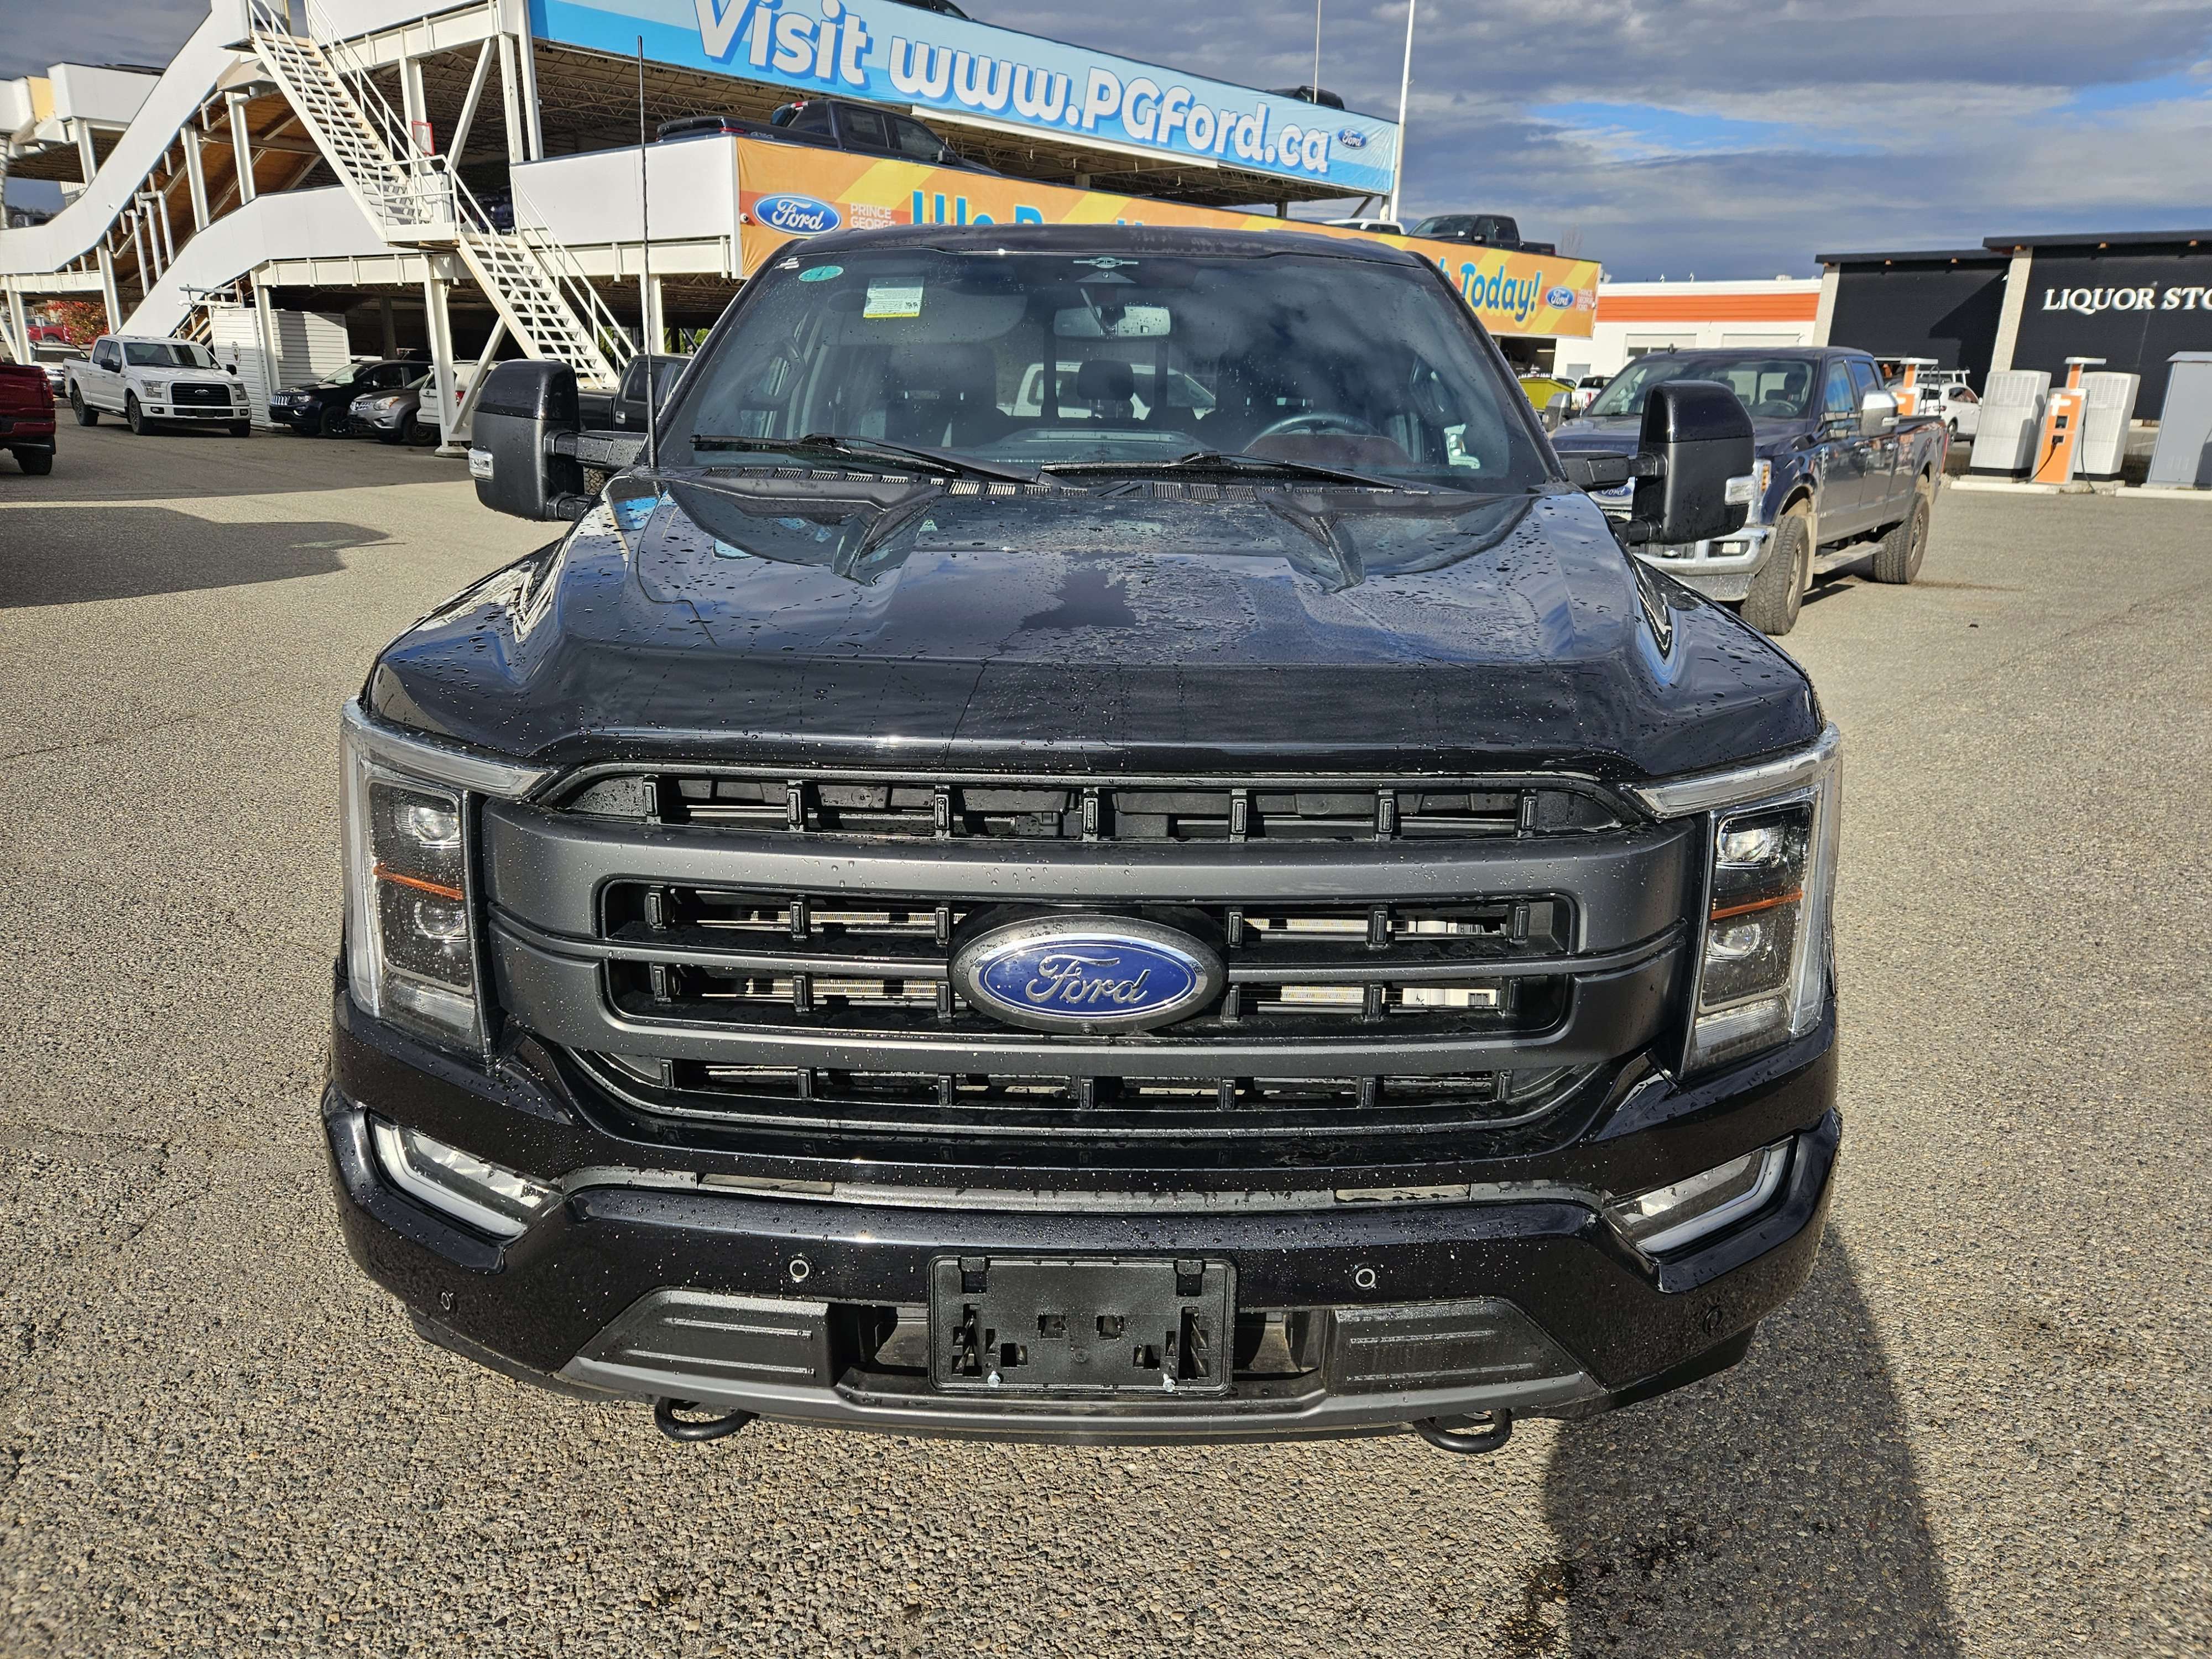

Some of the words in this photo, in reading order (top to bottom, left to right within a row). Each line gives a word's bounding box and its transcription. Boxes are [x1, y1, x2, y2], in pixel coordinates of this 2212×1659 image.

[695, 0, 868, 85] Visit
[889, 35, 1329, 173] www.PGford.ca
[772, 197, 825, 231] Ford
[850, 203, 891, 220] PRINCE
[1460, 263, 1541, 322] Today!
[2042, 288, 2155, 315] LIQUOR
[1026, 953, 1151, 1005] Ford
